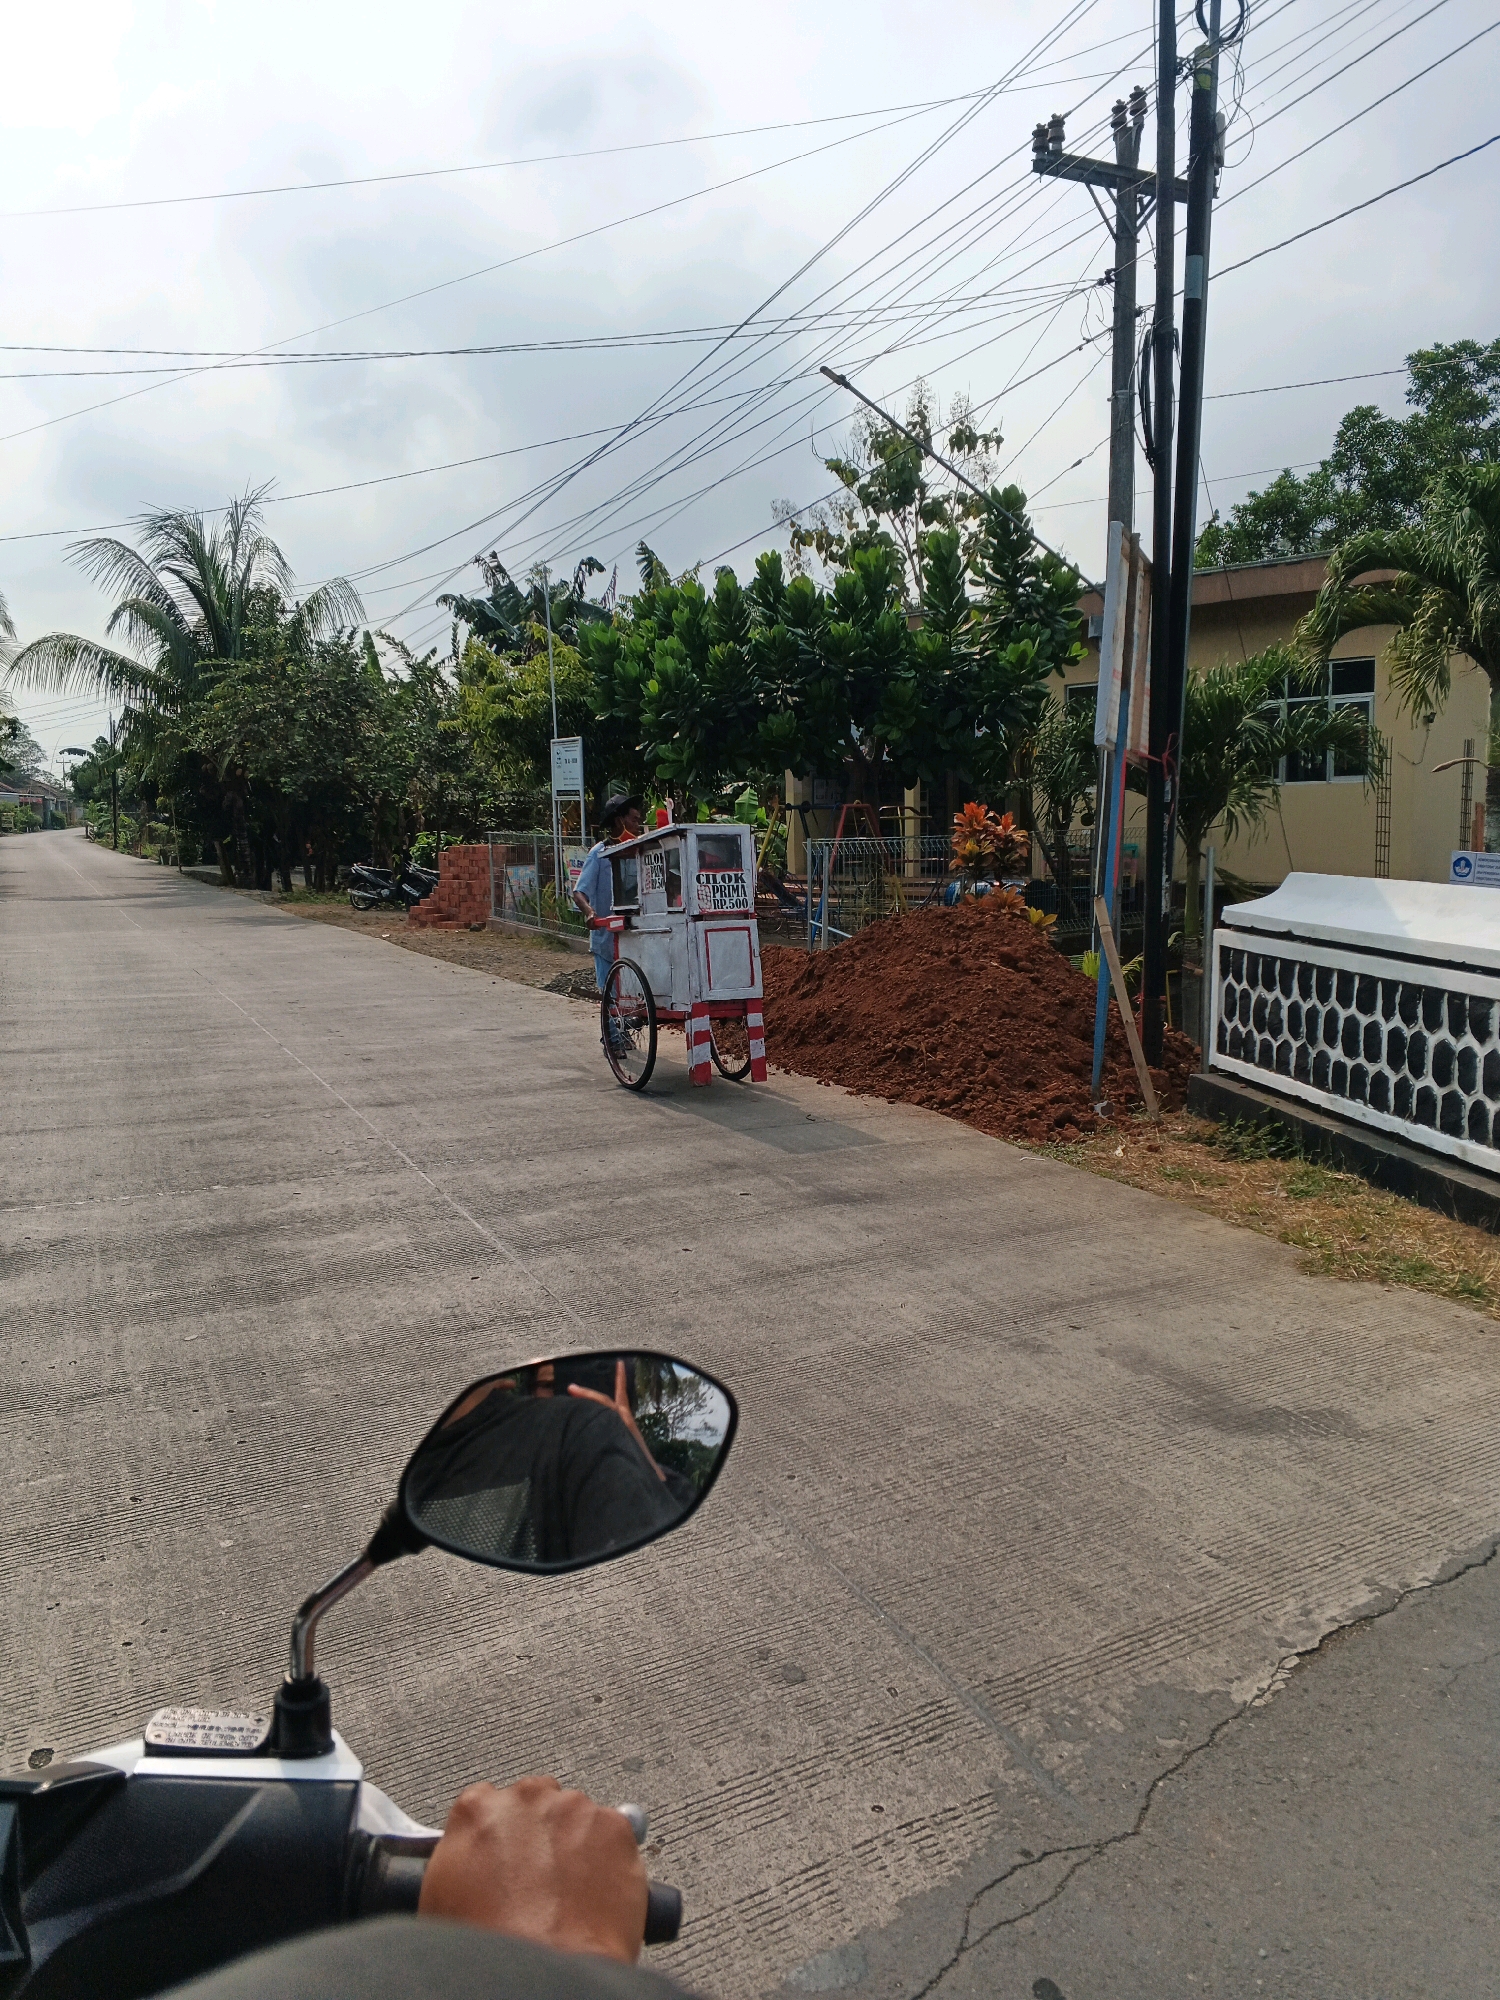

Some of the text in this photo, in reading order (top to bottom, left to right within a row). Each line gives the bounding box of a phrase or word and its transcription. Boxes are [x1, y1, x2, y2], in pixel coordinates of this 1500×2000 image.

[696, 873, 746, 884] CILOK
[712, 884, 747, 898] PRIMA
[713, 898, 748, 909] RP.500
